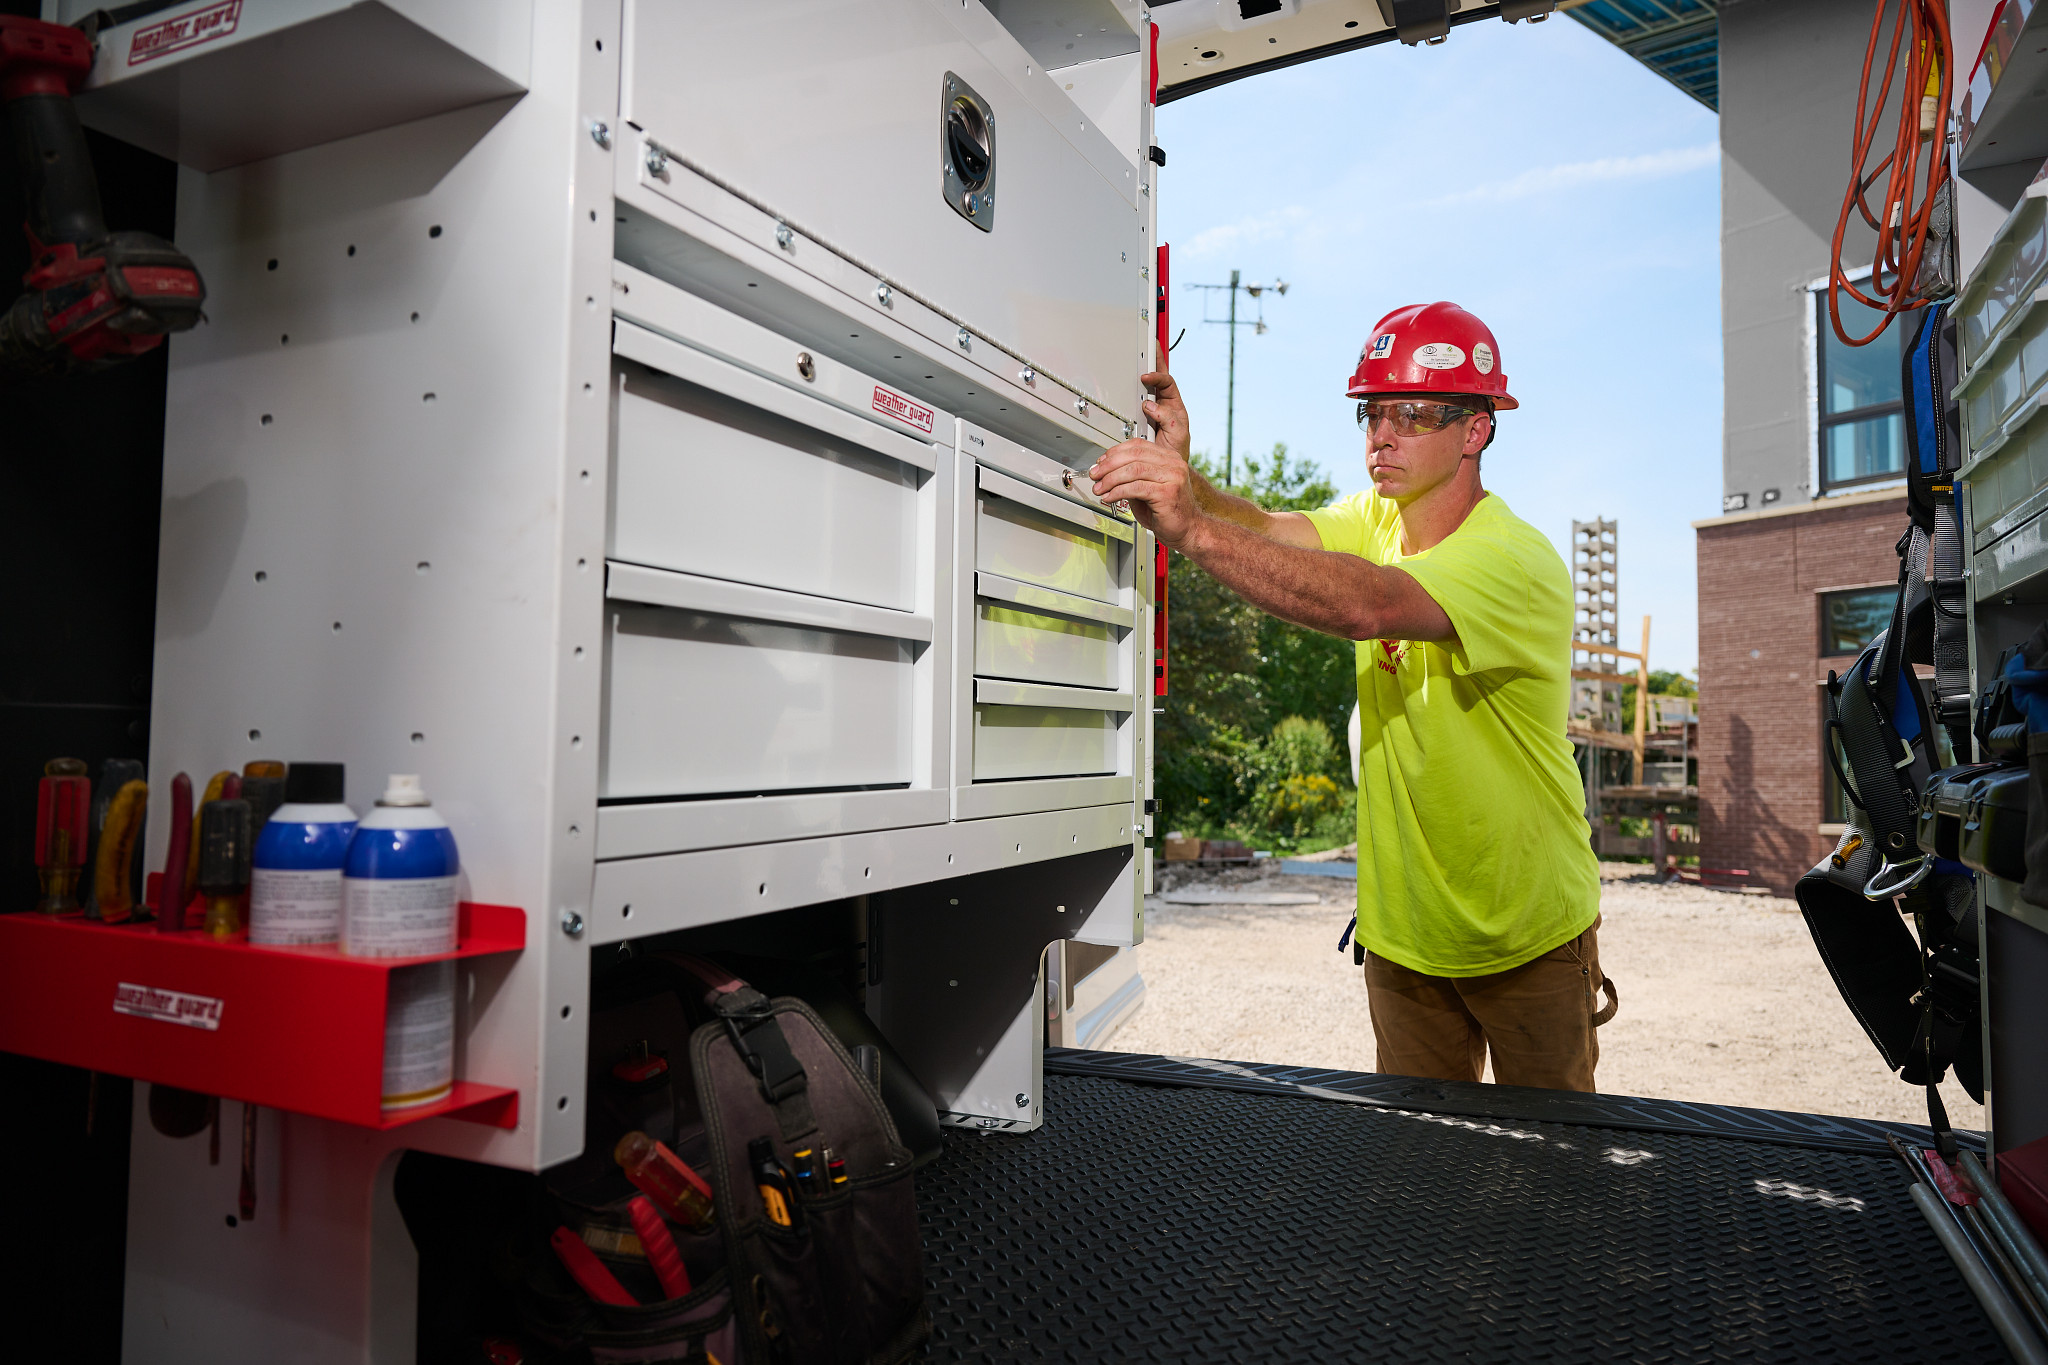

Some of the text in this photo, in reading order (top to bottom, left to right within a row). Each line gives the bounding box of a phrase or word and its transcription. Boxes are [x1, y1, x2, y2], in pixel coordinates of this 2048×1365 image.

[132, 1, 235, 51] weather guard
[874, 391, 931, 425] weather guard
[1378, 657, 1398, 675] ING
